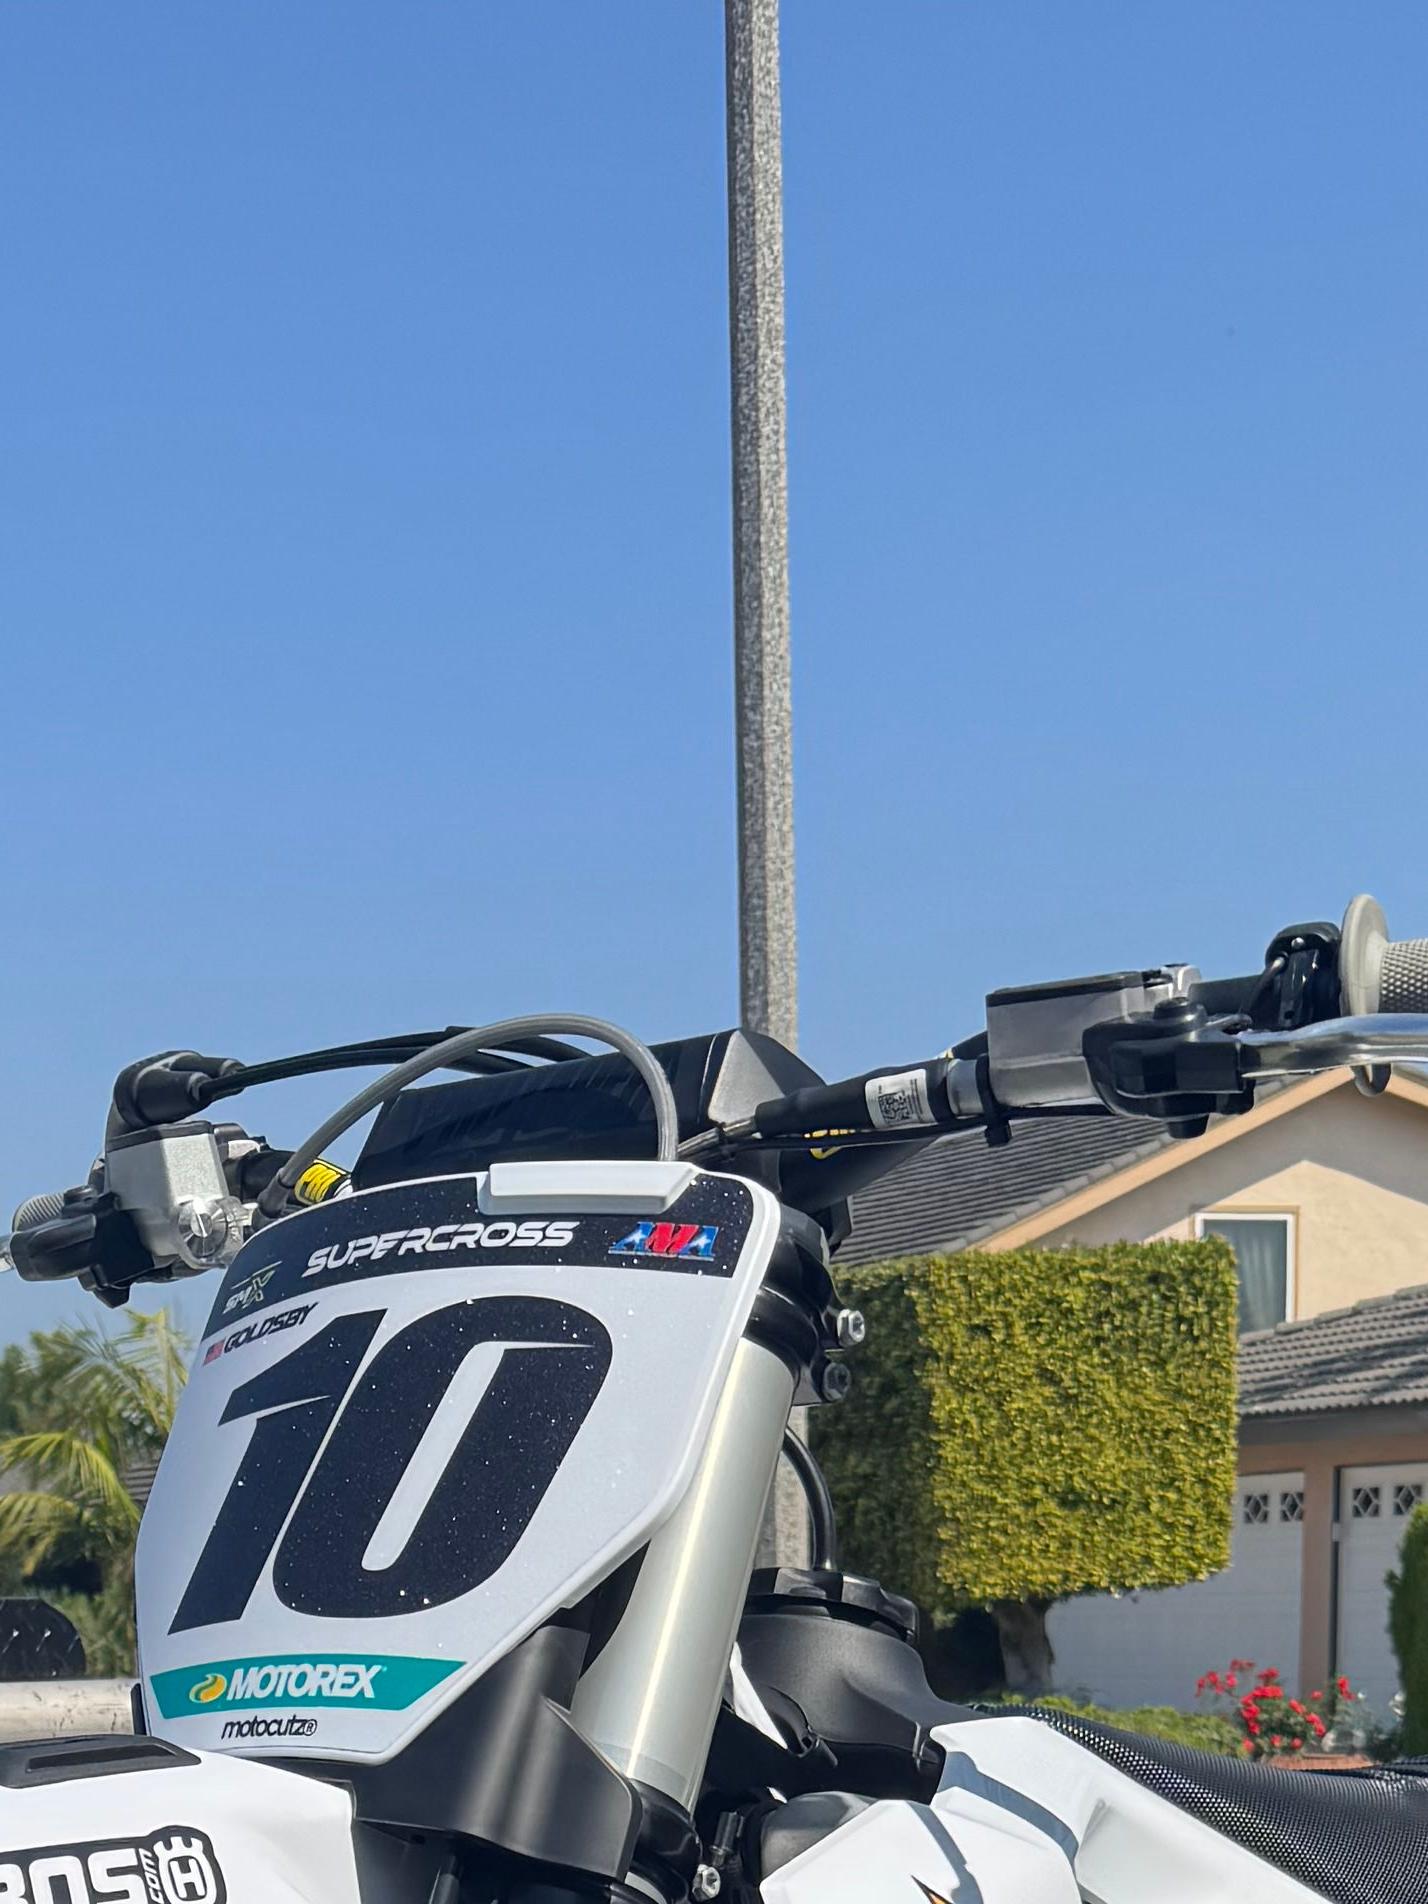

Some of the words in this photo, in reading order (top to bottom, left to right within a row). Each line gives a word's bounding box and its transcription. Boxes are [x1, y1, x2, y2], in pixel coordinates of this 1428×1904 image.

[300, 1221, 580, 1278] SUPERCROSS
[608, 1221, 719, 1261] AMA
[224, 1301, 320, 1353] GOLDSBY
[167, 1296, 613, 1636] 10
[226, 1664, 382, 1701] MOTOREX
